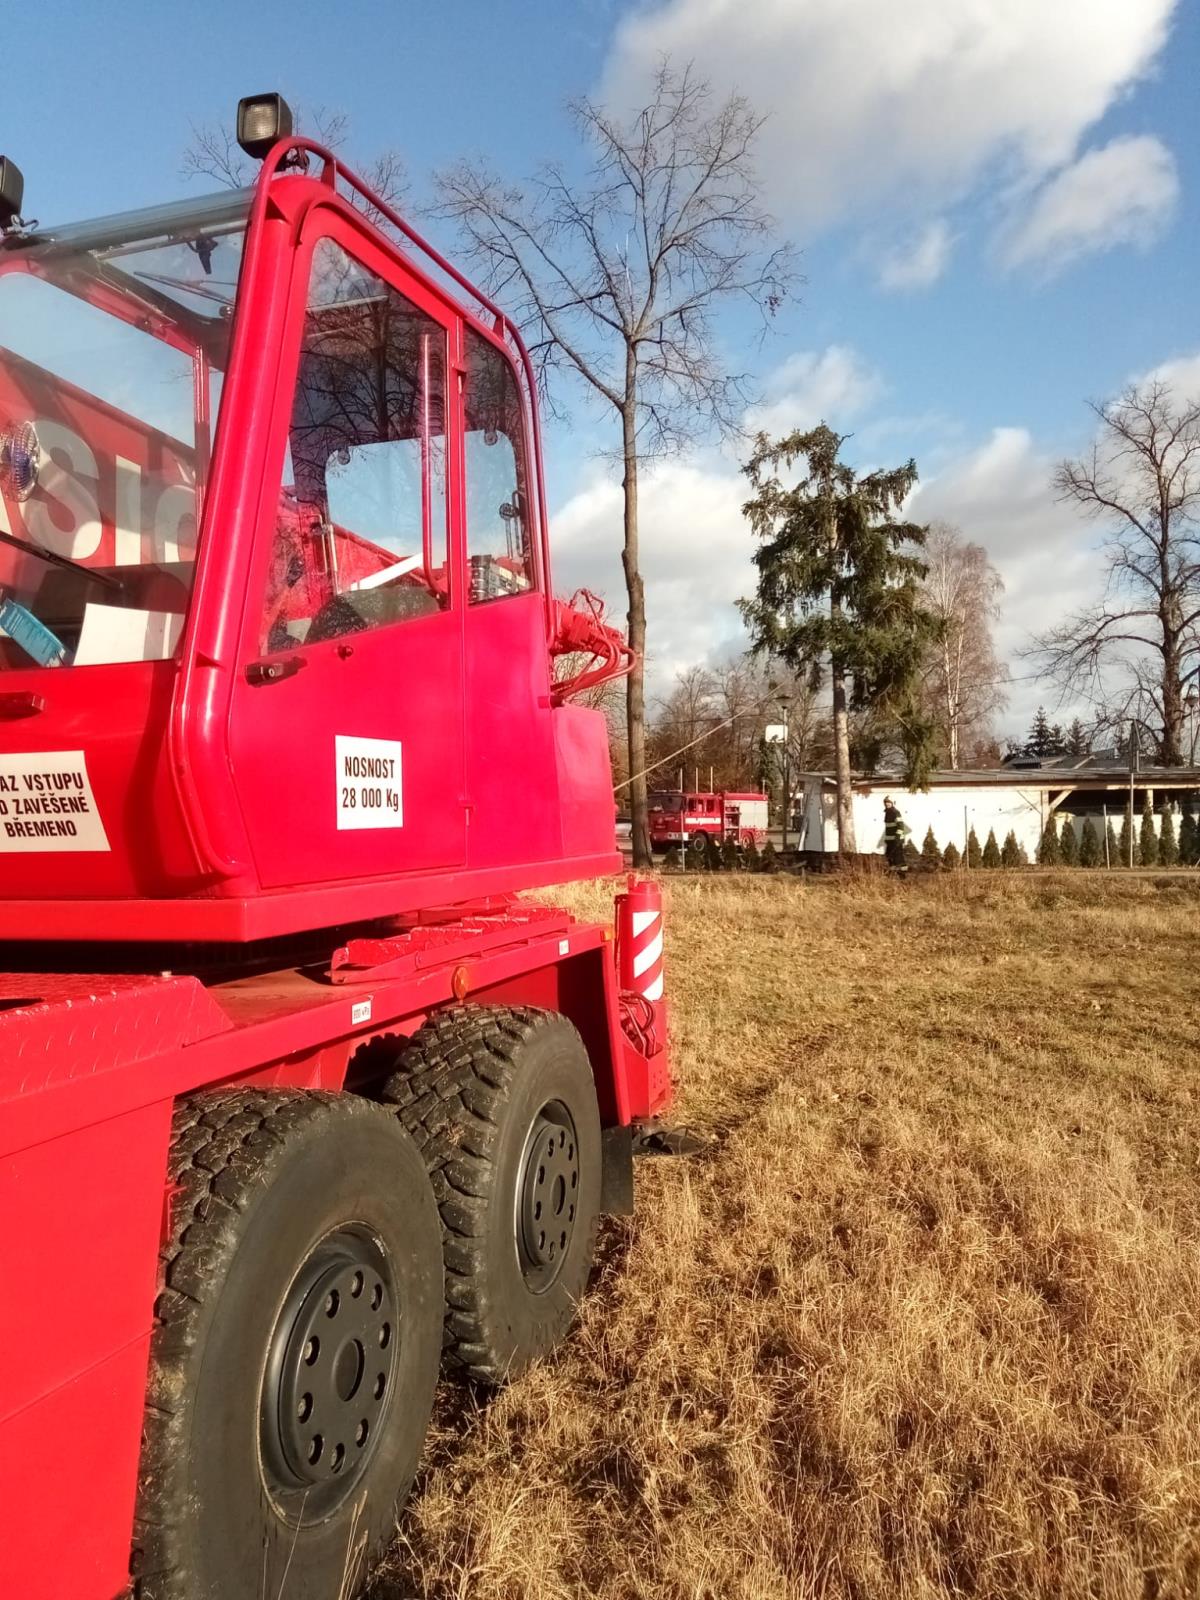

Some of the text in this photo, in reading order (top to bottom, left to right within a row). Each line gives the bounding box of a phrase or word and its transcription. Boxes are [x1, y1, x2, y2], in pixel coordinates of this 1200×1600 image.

[345, 756, 395, 778] NOSNOST
[22, 772, 84, 791] VSTUPU
[12, 792, 89, 815] ZAVĚŠENÉ
[342, 787, 399, 812] 28 000 Kg
[4, 817, 77, 837] BŘEMENO
